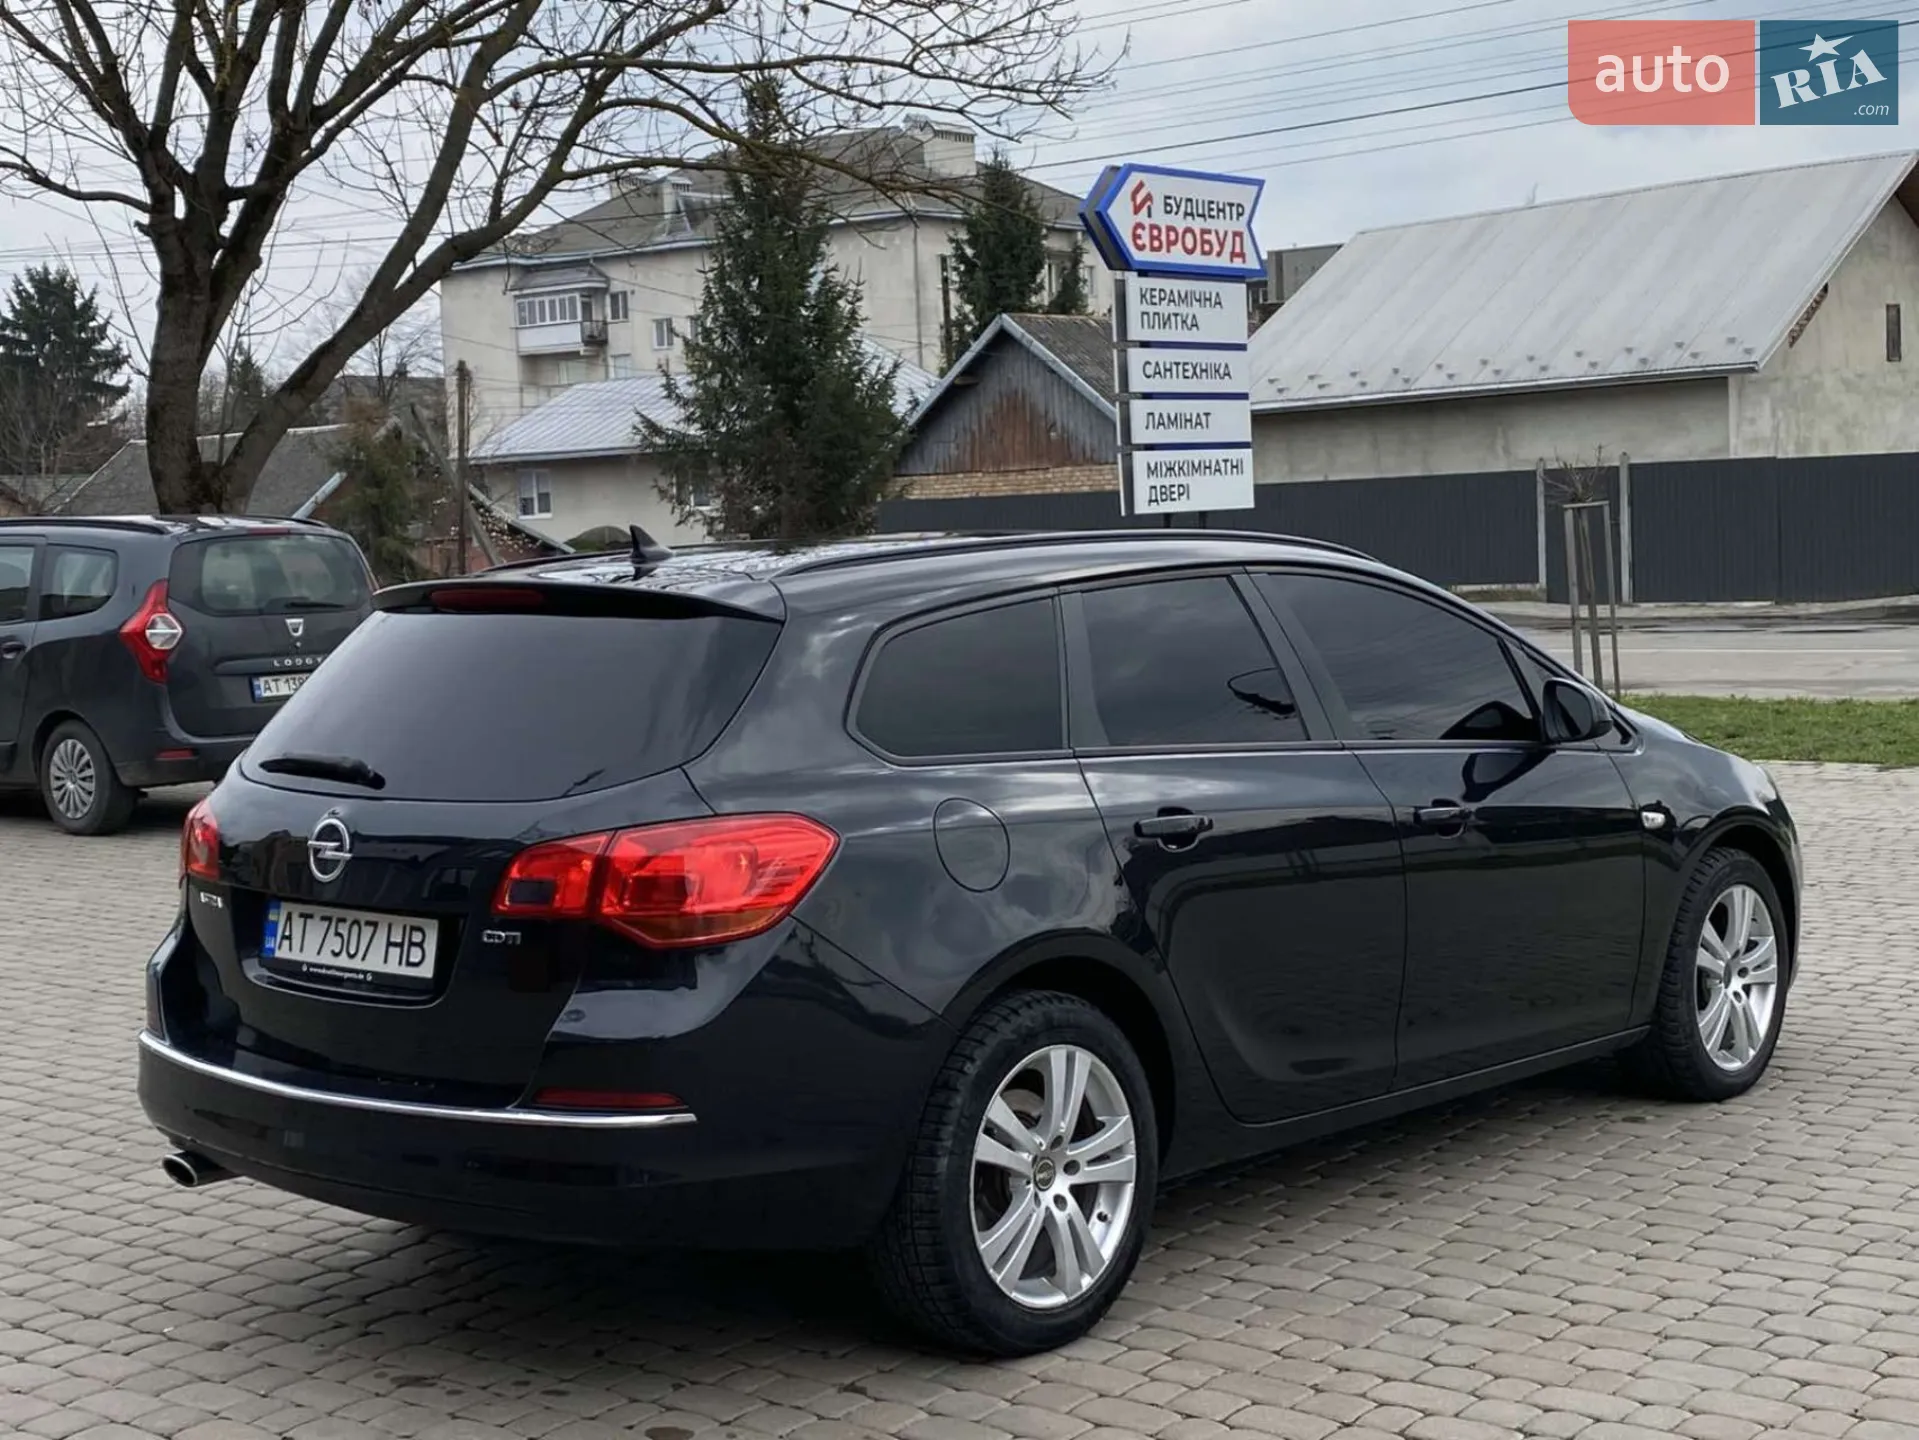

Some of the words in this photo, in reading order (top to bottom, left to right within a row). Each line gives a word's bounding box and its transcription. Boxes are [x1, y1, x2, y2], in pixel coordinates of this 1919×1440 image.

[1163, 195, 1245, 222] БУДЦЕНТР
[1131, 222, 1245, 264] ЄВРОБУД
[1139, 287, 1223, 309] КЕРАМІЧНА
[1140, 311, 1200, 332] ПЛИТКА
[1142, 360, 1232, 380] САНТЕХНІКА
[1144, 412, 1211, 431] ЛАМІНАТ
[1146, 458, 1244, 480] МІЖКІМНАТНІ
[1147, 483, 1190, 506] ДВЕРІ
[263, 678, 281, 694] AT
[277, 911, 315, 953] AT
[319, 915, 379, 962] 7507
[383, 923, 427, 968] HB
